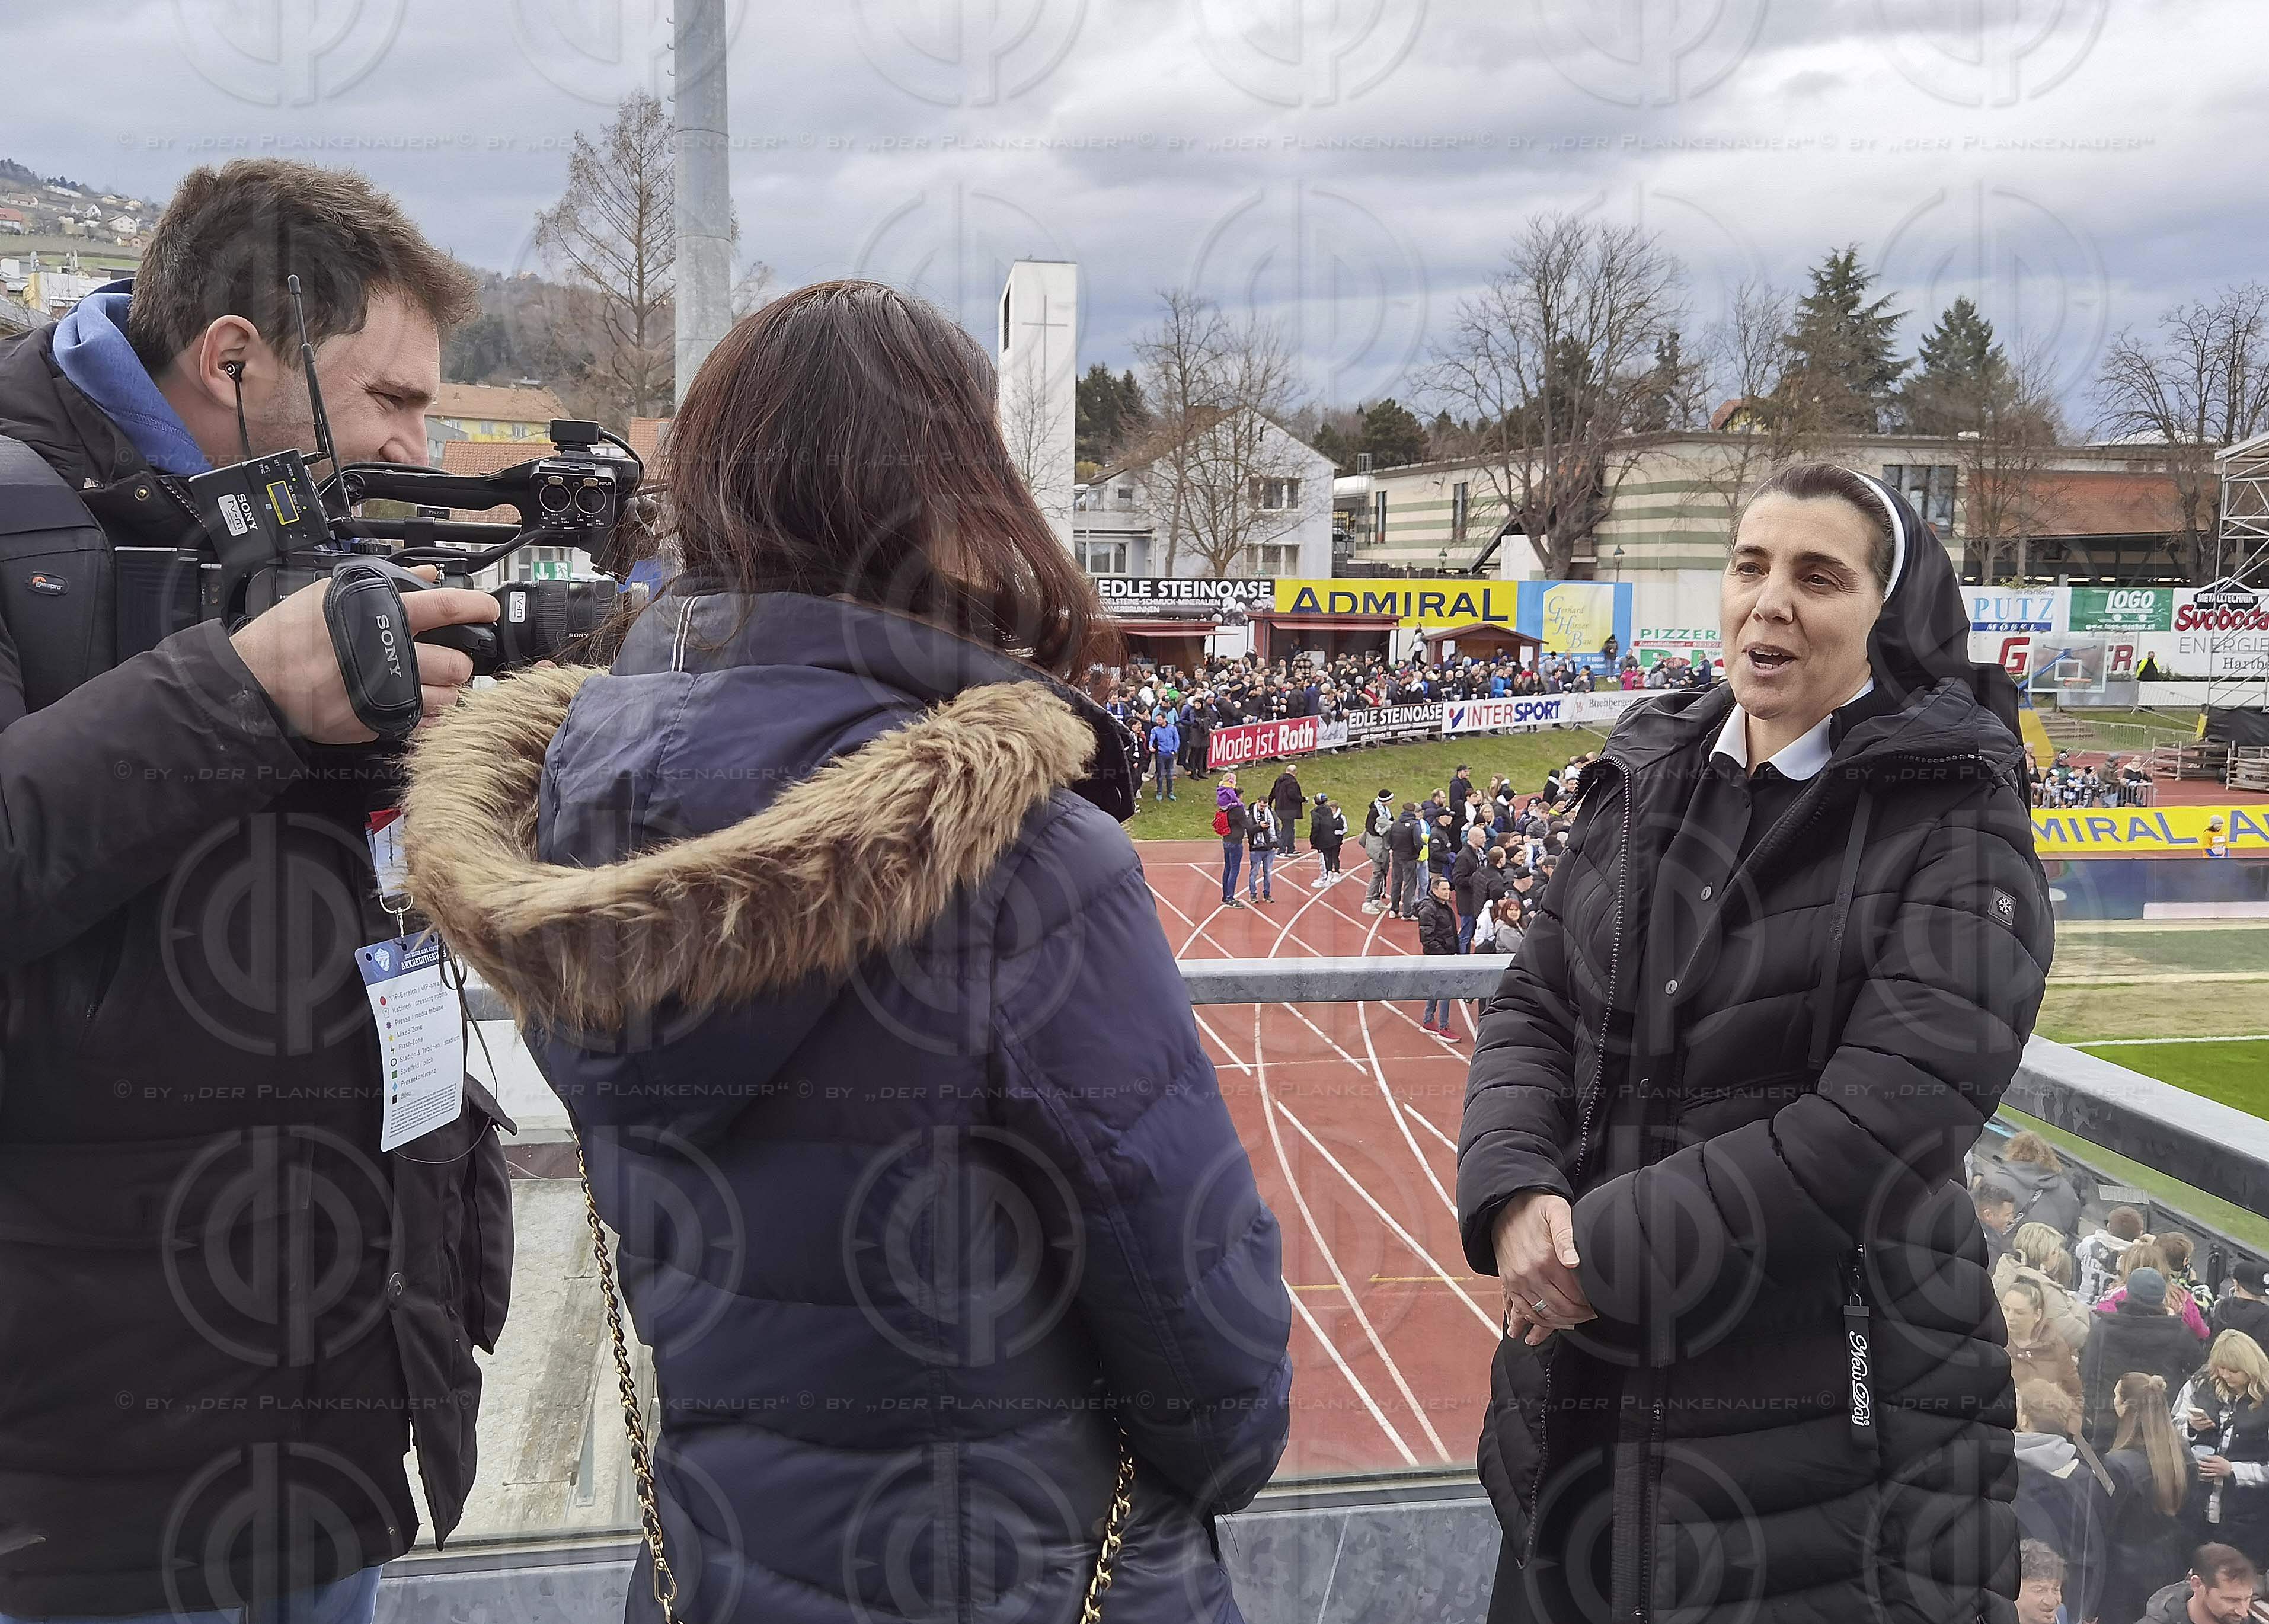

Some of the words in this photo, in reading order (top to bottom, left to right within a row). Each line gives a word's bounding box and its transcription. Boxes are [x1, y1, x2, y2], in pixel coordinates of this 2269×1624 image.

[237, 494, 258, 530] SONY
[1098, 580, 1151, 597] EDLE
[1157, 581, 1271, 598] STEINOASE
[2105, 590, 2155, 613] LOGO
[1289, 587, 1508, 621] ADMIRAL
[1973, 598, 2053, 620] PUTZ
[2175, 605, 2269, 631] Svoboda
[376, 615, 402, 677] SONY
[2223, 657, 2269, 669] Hartb
[1348, 710, 1378, 728] EDLE
[1380, 704, 1442, 724] STEINOASE
[1468, 700, 1561, 727] INTERSPORT
[1212, 730, 1252, 763] Mode
[1257, 727, 1275, 755] ist
[1278, 720, 1314, 751] Roth
[2032, 811, 2198, 845] MIRAL
